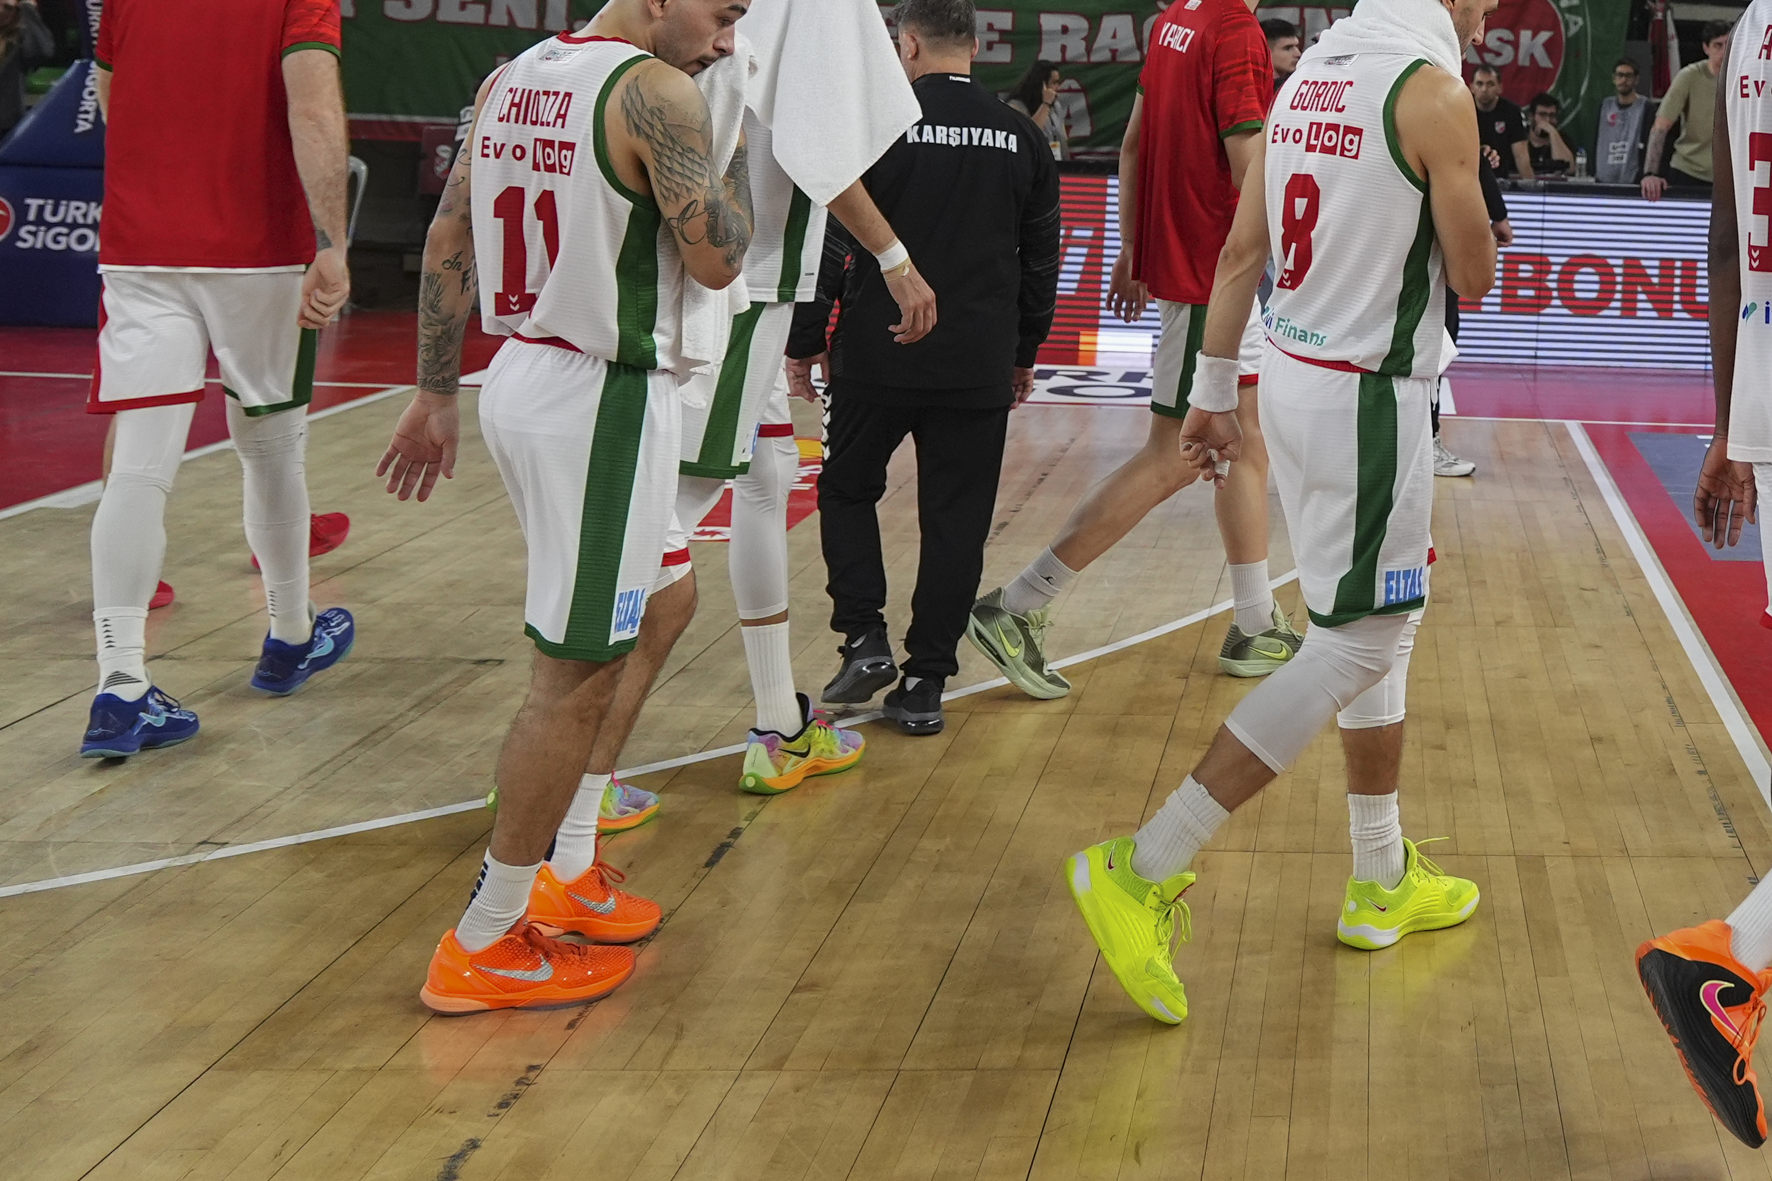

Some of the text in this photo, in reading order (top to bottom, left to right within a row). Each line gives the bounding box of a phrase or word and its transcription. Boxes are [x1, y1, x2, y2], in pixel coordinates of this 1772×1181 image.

[497, 86, 574, 130] CHIOZZA
[1290, 80, 1354, 113] GORDIC
[905, 124, 1019, 154] KARŞIYAKA
[1276, 173, 1321, 291] 8
